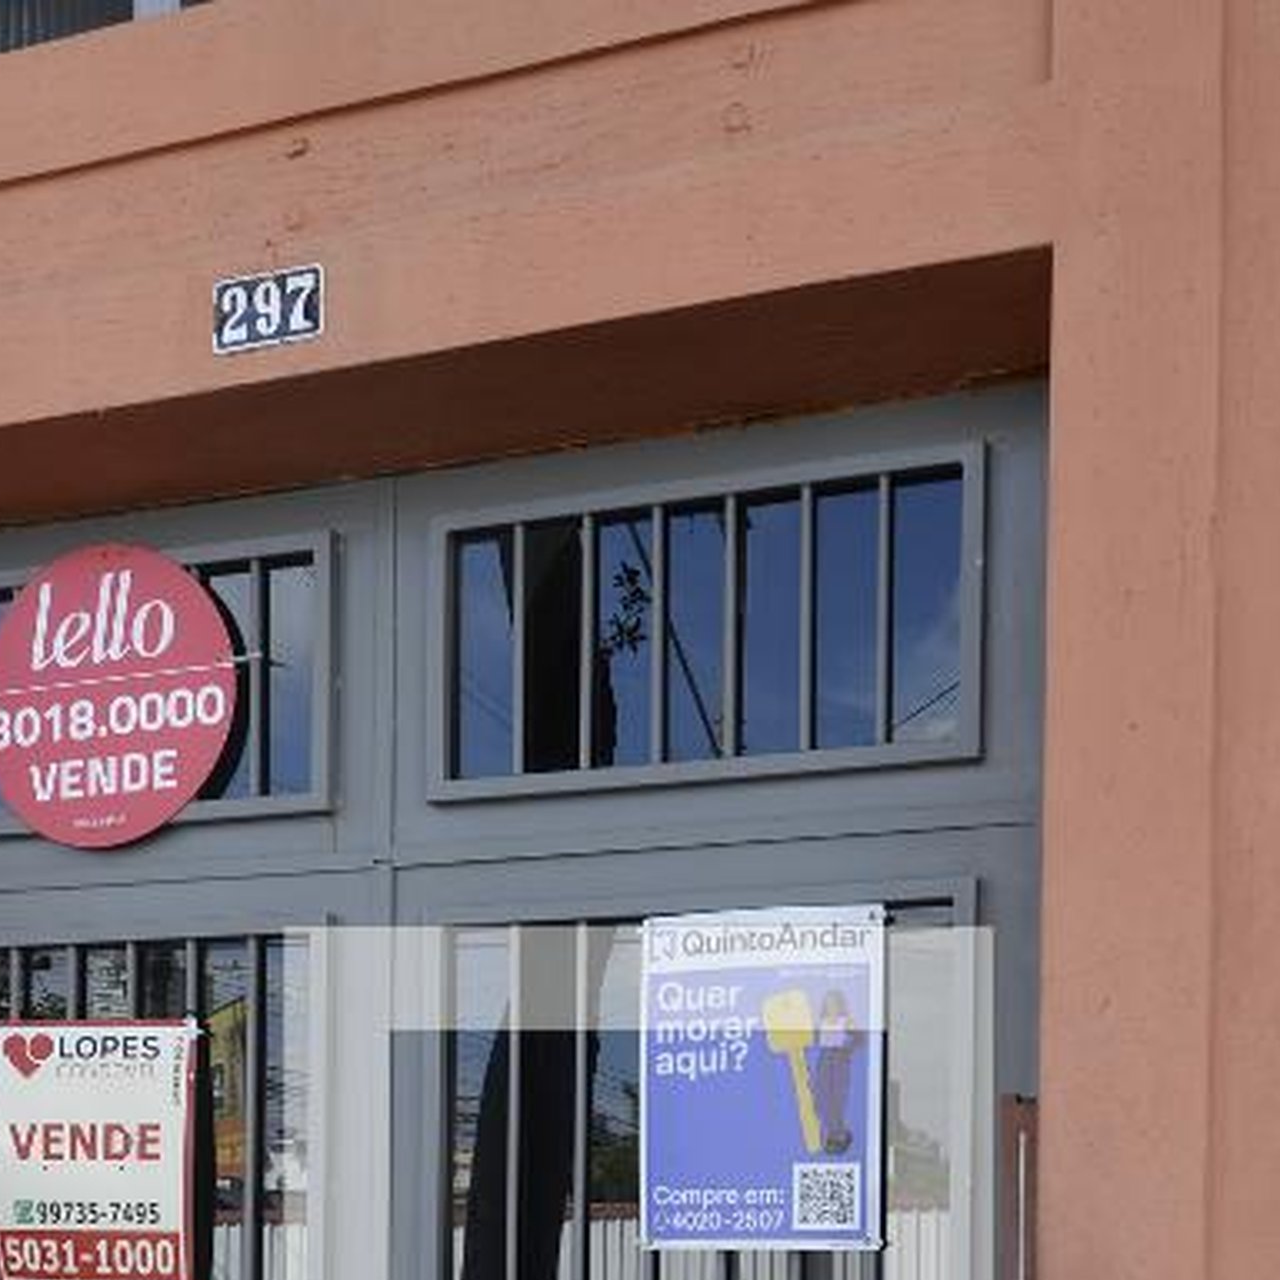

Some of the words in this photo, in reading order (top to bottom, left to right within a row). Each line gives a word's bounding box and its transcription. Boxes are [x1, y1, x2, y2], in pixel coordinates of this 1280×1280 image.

[221, 272, 316, 344] 297
[31, 569, 174, 671] lello
[29, 750, 178, 801] VENDE
[681, 923, 871, 958] QuintoAndar
[657, 981, 743, 1014] Quer
[58, 1035, 161, 1059] LOPES
[657, 1014, 759, 1044] morar
[654, 1041, 749, 1079] aqui?
[9, 1123, 161, 1161] VENDE
[36, 1200, 161, 1225] 99735-7495
[652, 1185, 740, 1209] Compre
[745, 1187, 785, 1206] em:
[4, 1238, 175, 1275] 5031-1000
